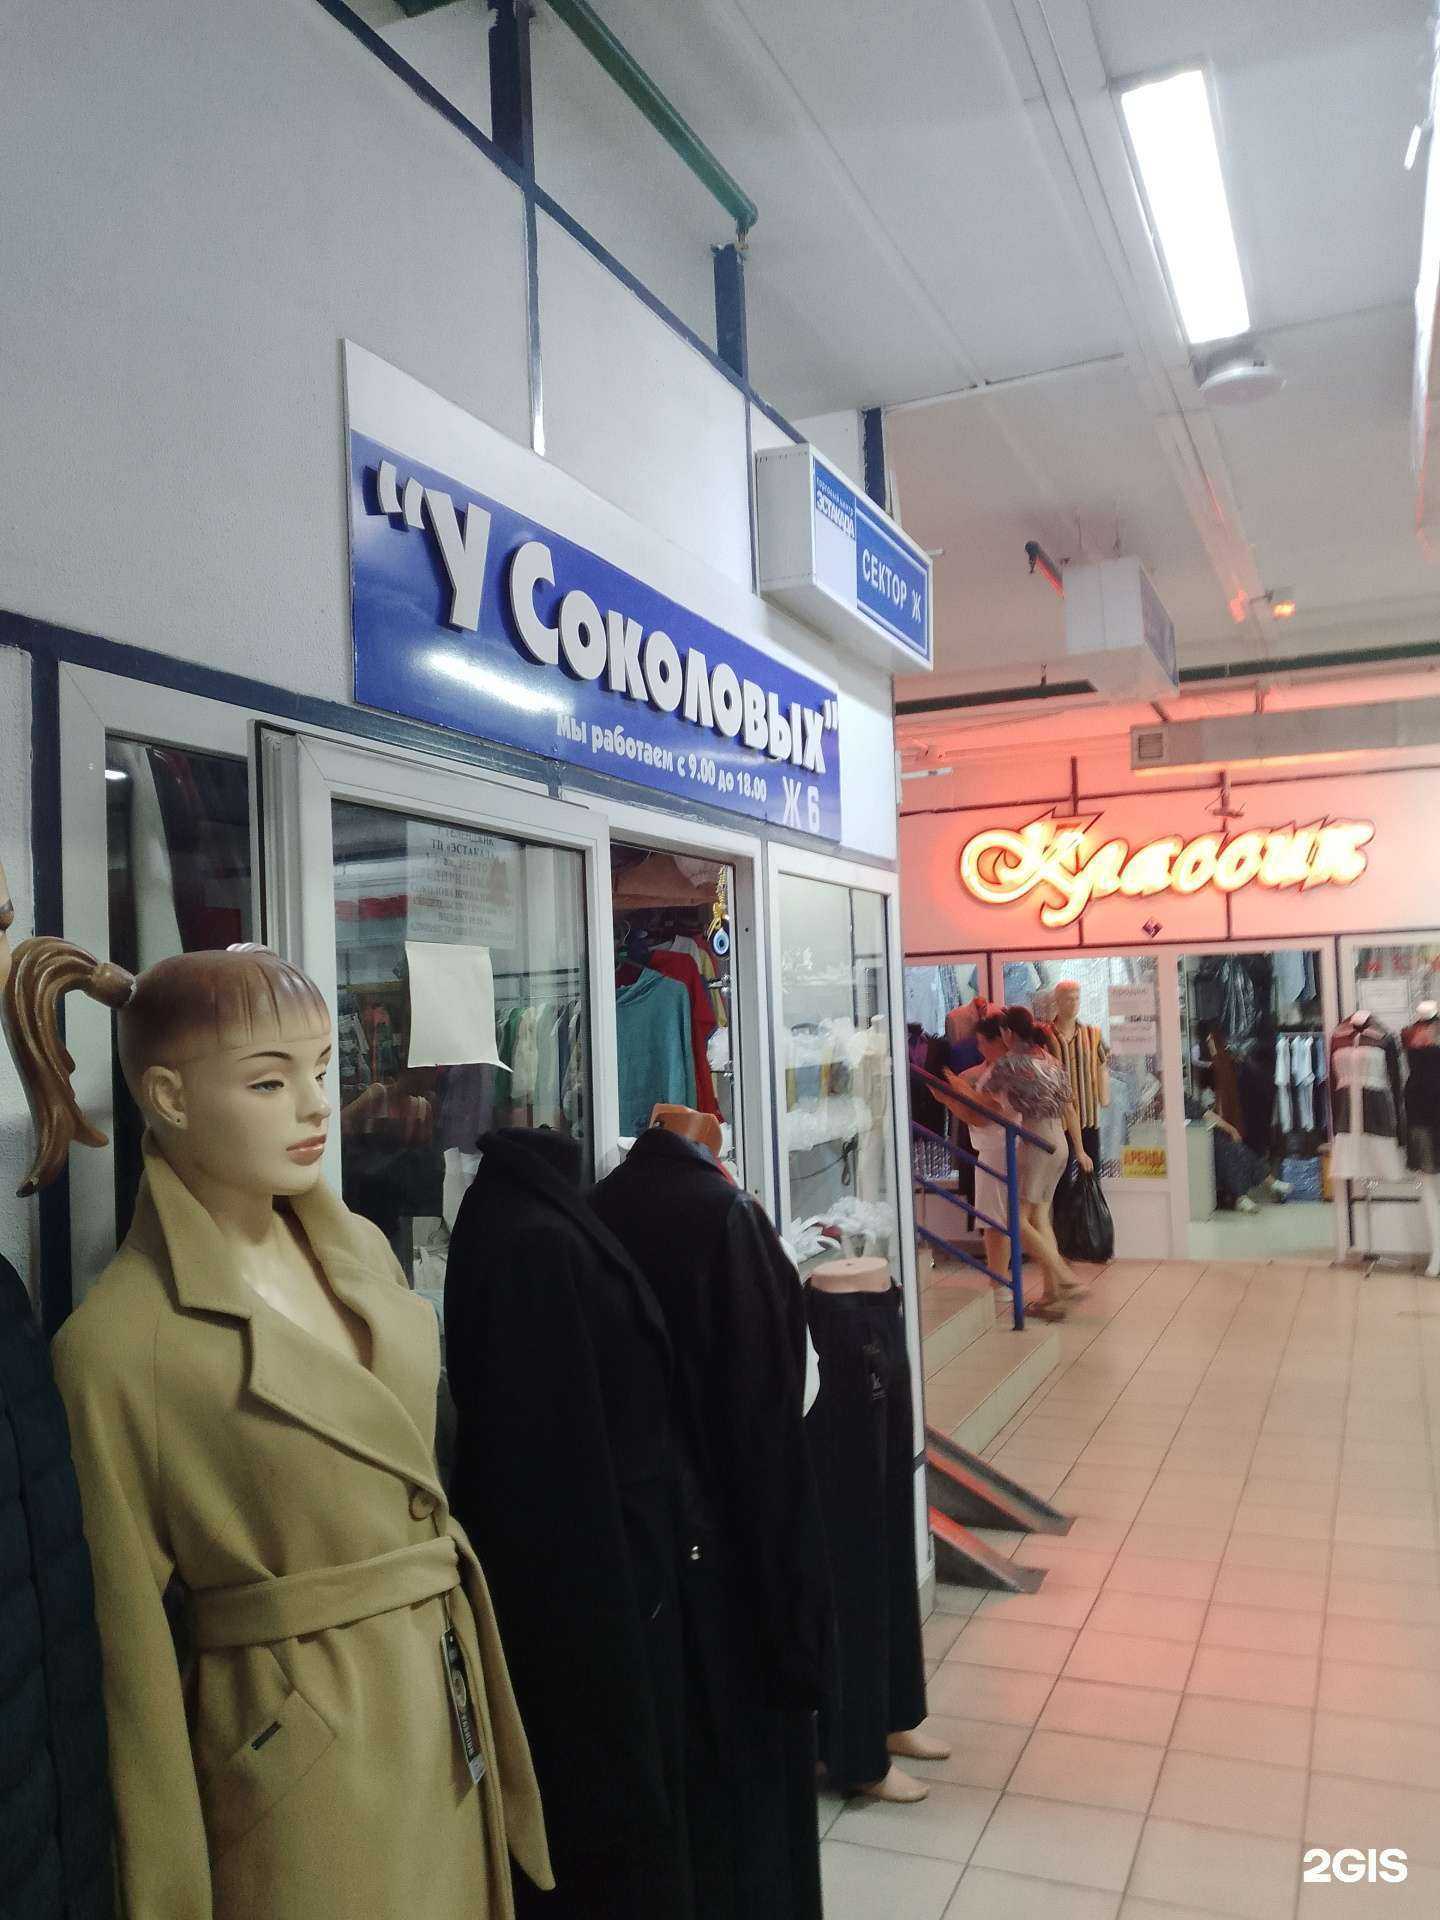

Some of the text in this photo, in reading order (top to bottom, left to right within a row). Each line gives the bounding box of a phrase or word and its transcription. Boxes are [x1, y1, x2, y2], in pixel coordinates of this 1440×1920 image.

[816, 490, 856, 539] ЭСТАКАДА
[862, 549, 922, 624] СЕКТОР Ж
[557, 715, 767, 803] Мы работаем с 9.00 до 18.00
[782, 776, 820, 832] Ж 6
